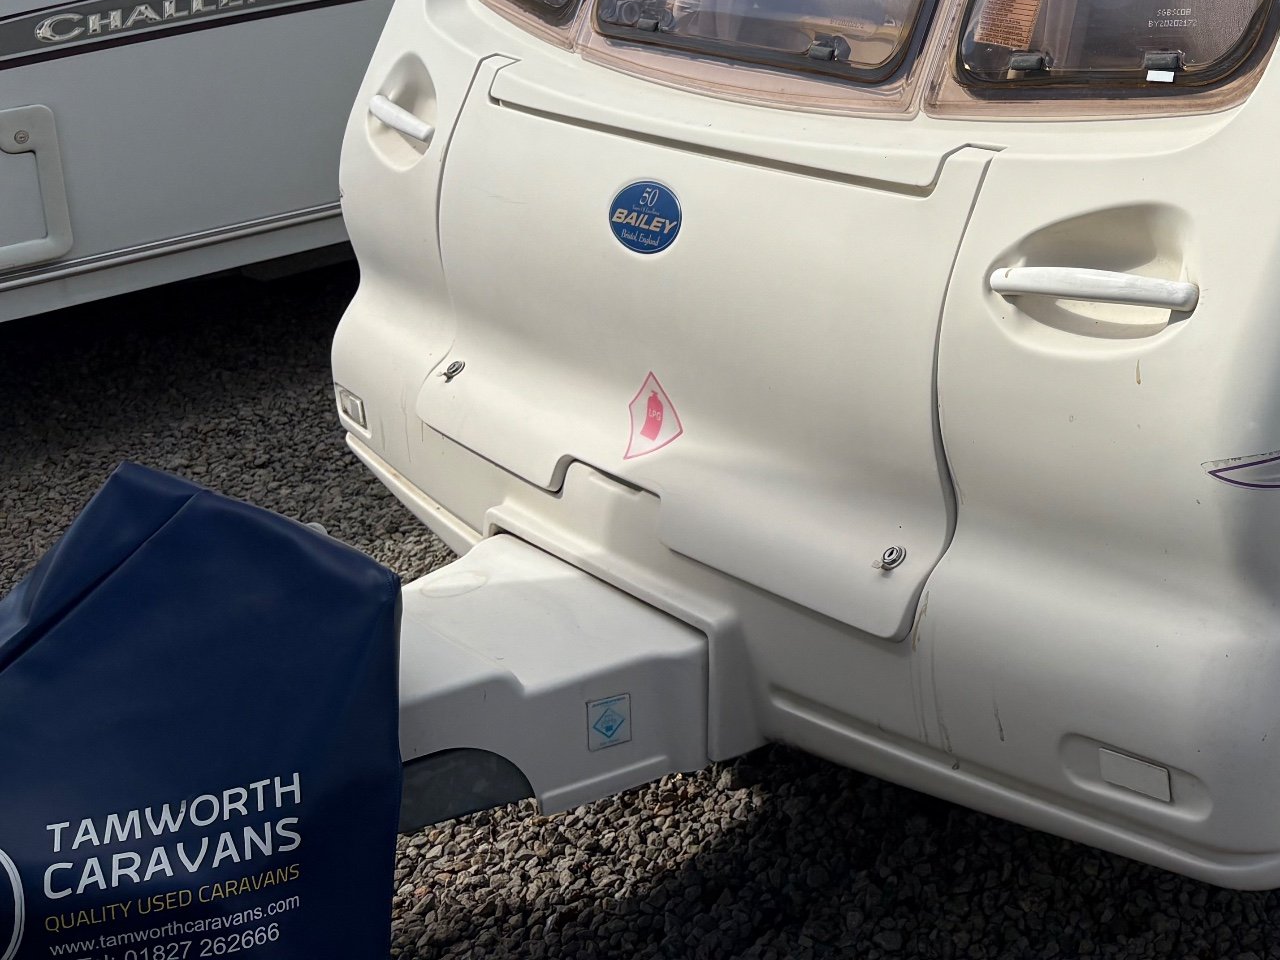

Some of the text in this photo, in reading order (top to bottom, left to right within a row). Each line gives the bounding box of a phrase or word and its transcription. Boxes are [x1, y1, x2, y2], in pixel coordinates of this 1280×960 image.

[611, 208, 678, 234] BAILEY
[640, 187, 660, 207] 50
[639, 232, 661, 246] England
[46, 772, 301, 853] TAMWORTH
[43, 817, 302, 900] CARAVANS
[45, 863, 300, 933] QUALITY USED CARAVANS
[49, 895, 300, 957] www.tamworthcaravans.com
[124, 922, 280, 960] 01827 262666
